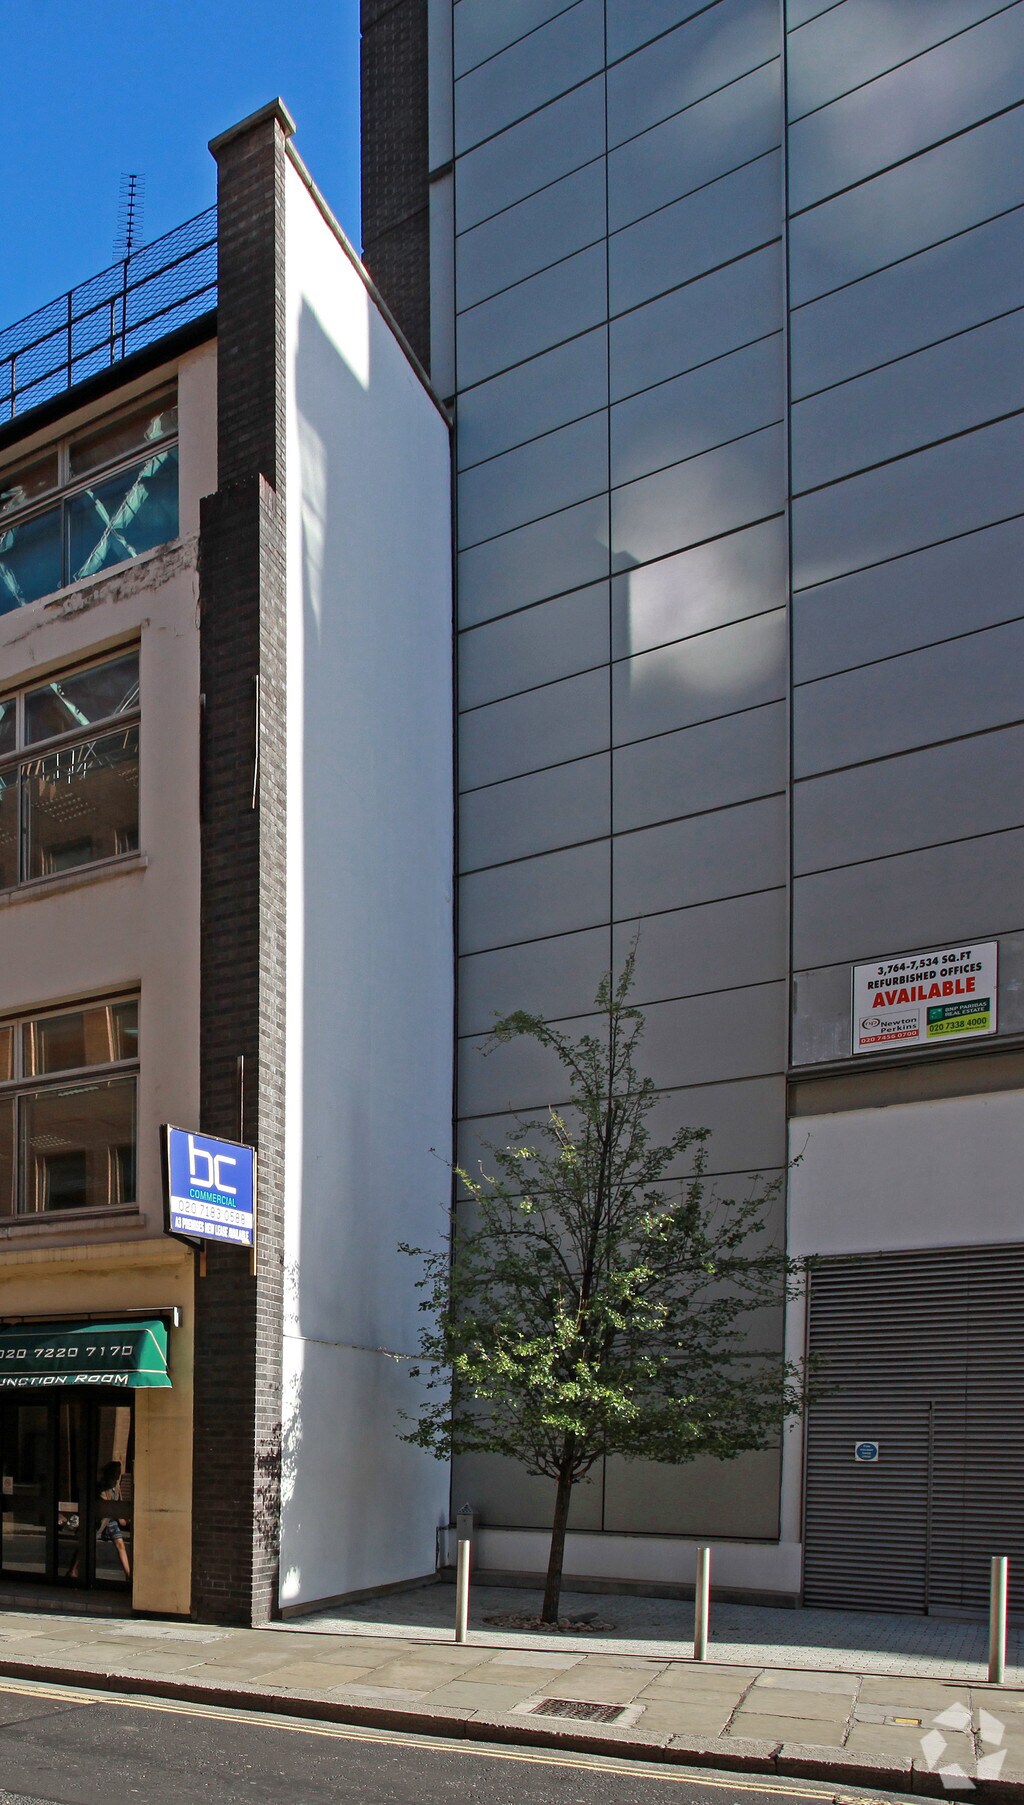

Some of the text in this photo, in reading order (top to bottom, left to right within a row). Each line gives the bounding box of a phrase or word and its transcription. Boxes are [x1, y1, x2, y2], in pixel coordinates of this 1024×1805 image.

[877, 951, 972, 977] 3,764-7,534 SQ.FT
[867, 962, 982, 990] REFURBISHED OFFICES
[872, 976, 976, 1009] AVAILABLE
[880, 1017, 917, 1027] Newton
[880, 1023, 917, 1033] Perkins
[929, 1023, 944, 1032] 020
[945, 1020, 965, 1030] 7338
[966, 1017, 987, 1026] 4000
[897, 1030, 917, 1038] 0700
[188, 1134, 237, 1195] bc
[189, 1188, 237, 1208] COMMERCIAL
[178, 1199, 197, 1214] 020
[200, 1204, 221, 1220] 7183
[34, 1347, 78, 1359] 7220
[86, 1345, 133, 1357] 7170
